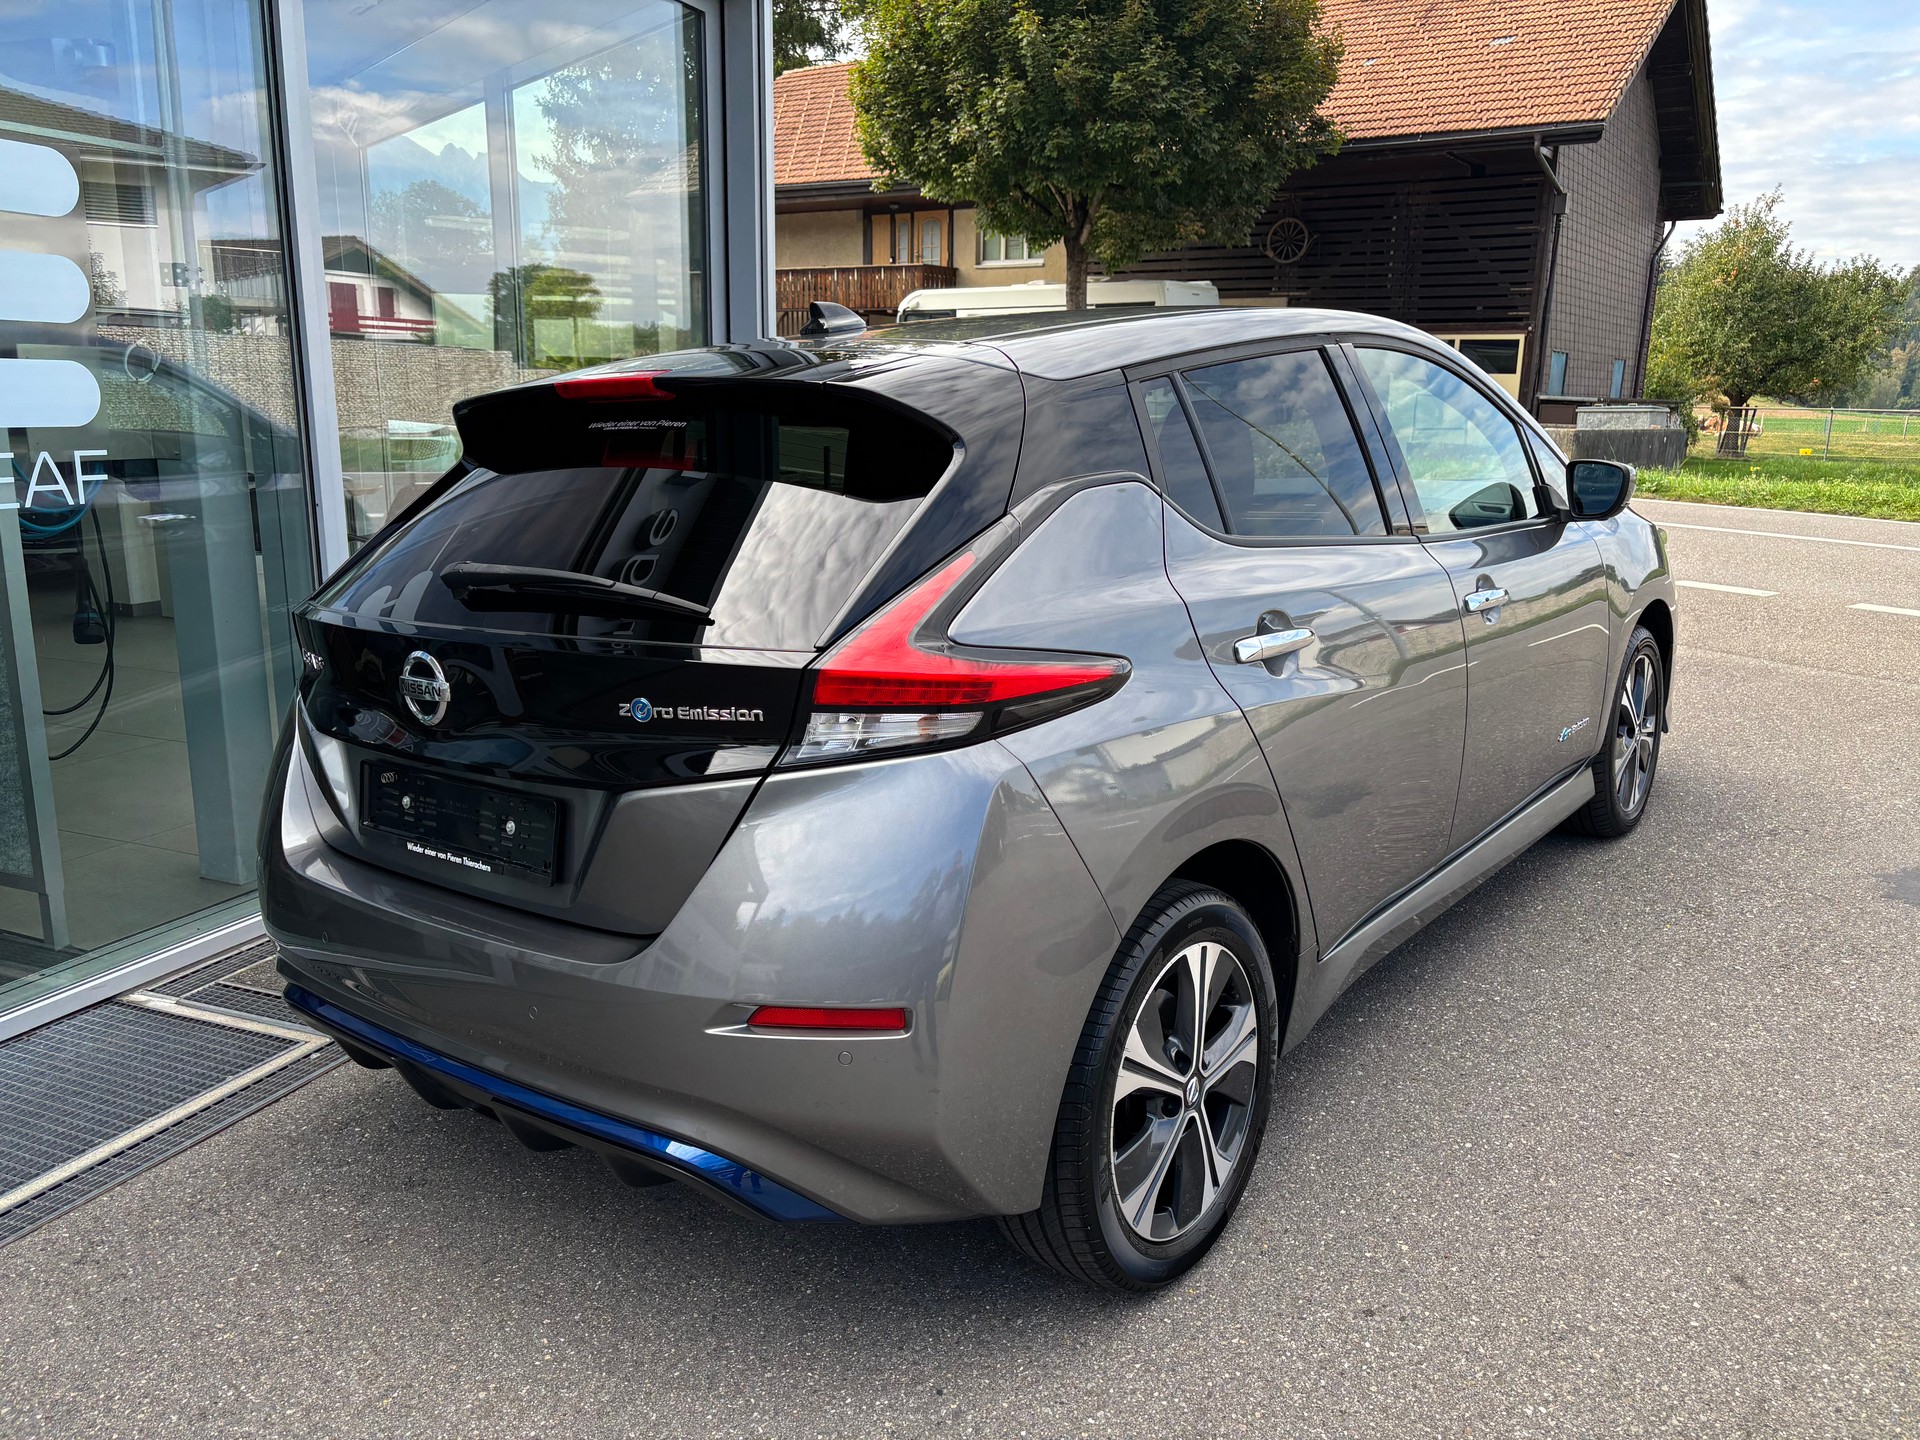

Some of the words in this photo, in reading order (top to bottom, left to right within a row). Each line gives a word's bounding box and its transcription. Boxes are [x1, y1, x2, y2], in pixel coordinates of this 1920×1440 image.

[657, 419, 687, 427] Pieren
[401, 681, 441, 697] NISSAN
[406, 841, 424, 854] Wieder
[424, 847, 437, 857] einer
[437, 851, 447, 860] von
[447, 852, 462, 864] Pieren
[463, 857, 491, 872] Thierachern
